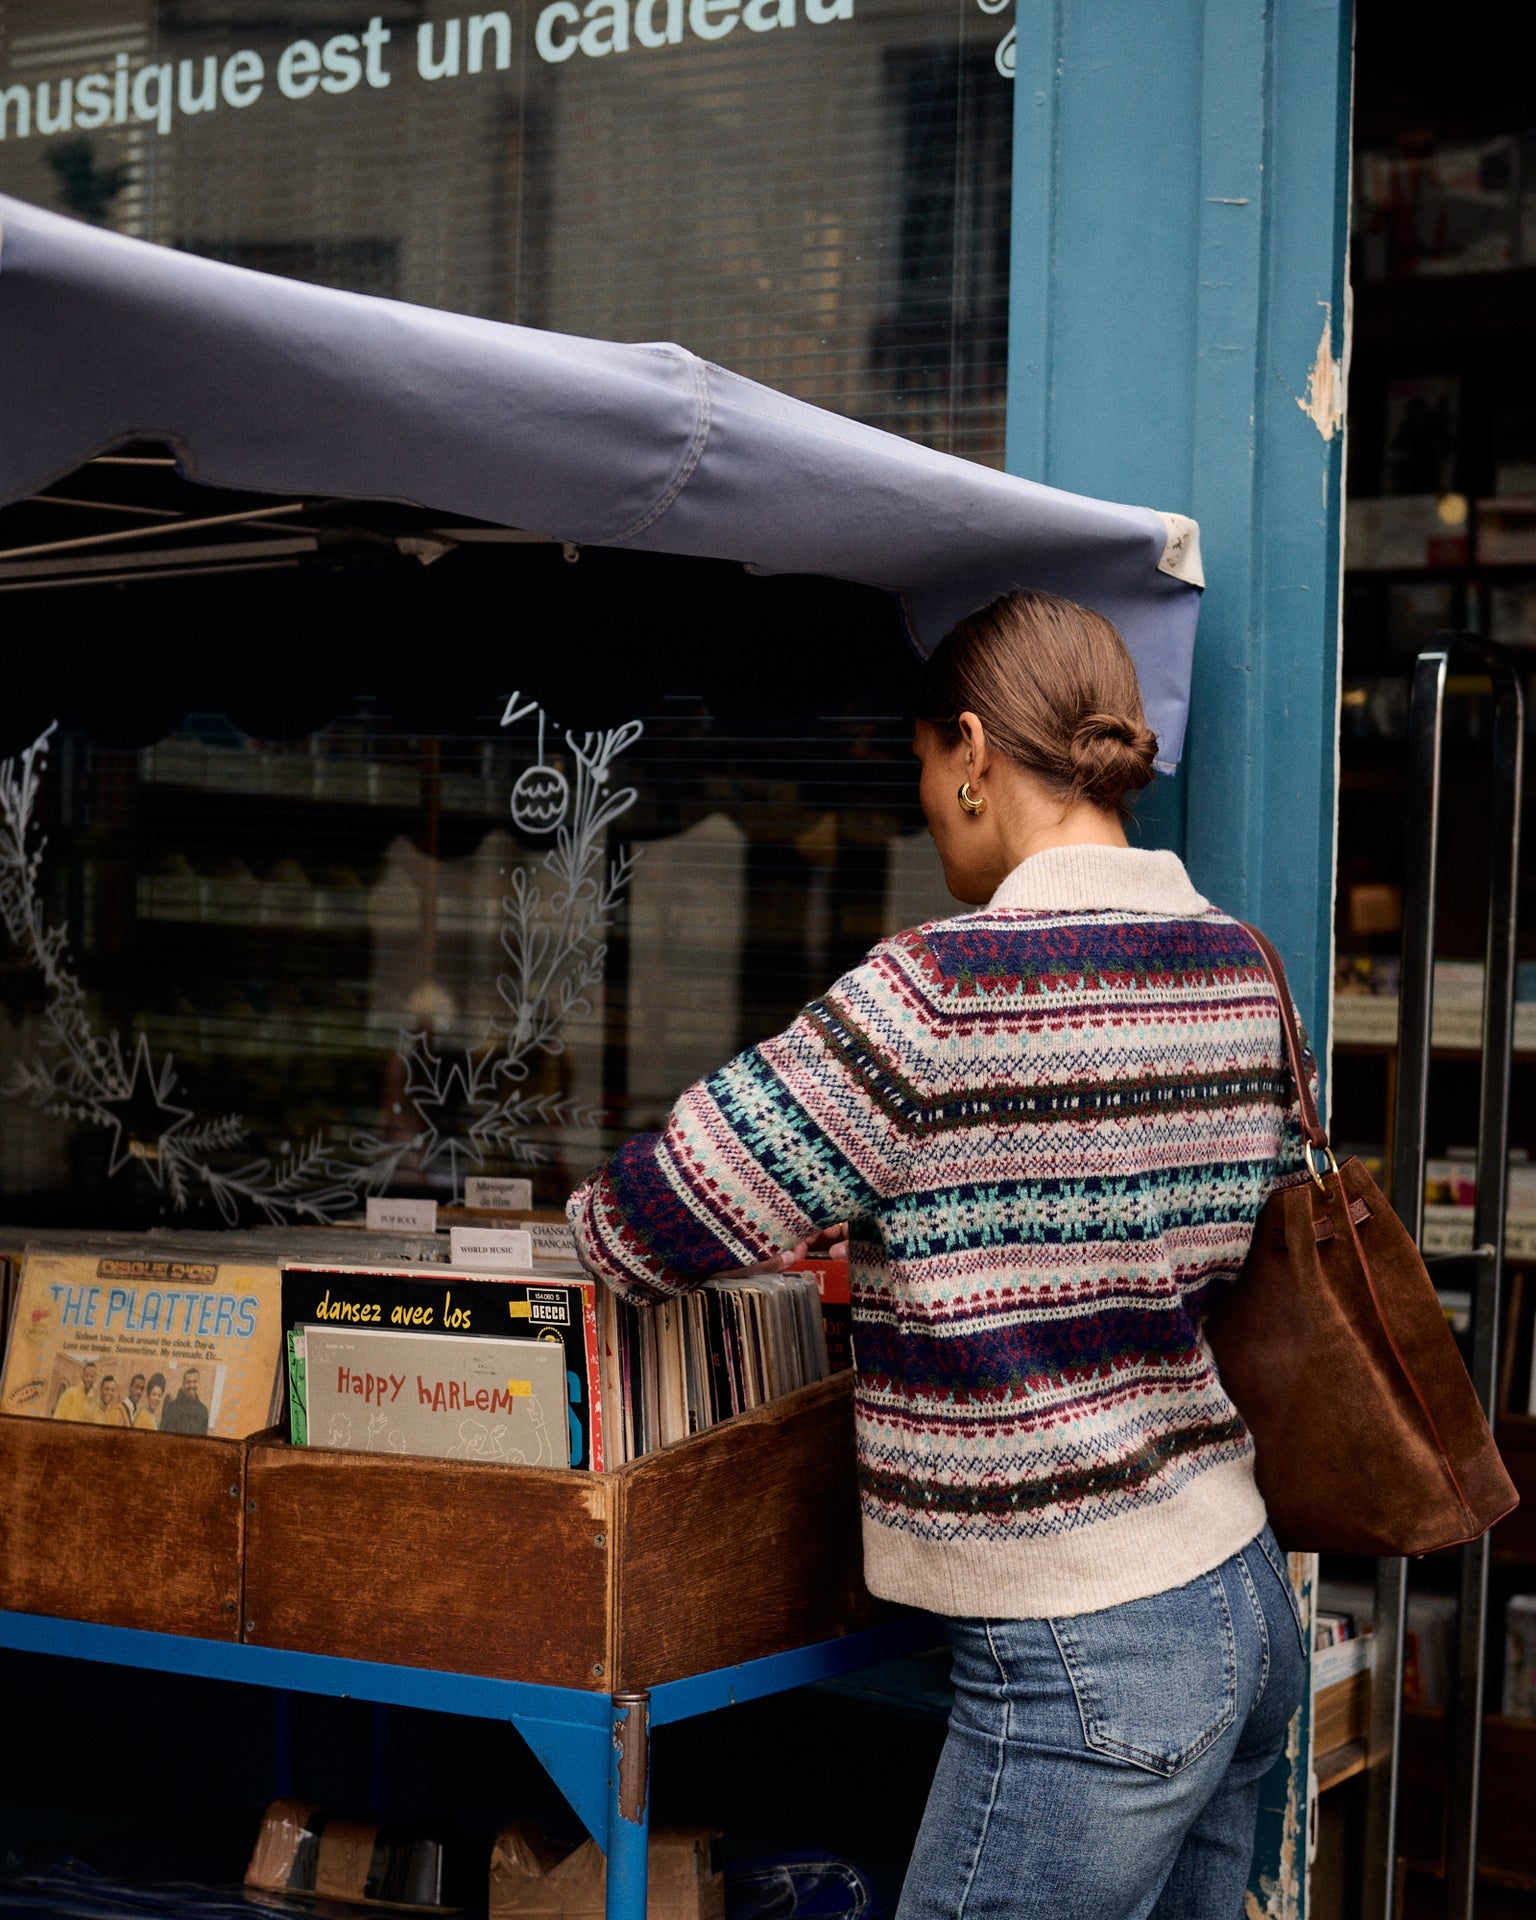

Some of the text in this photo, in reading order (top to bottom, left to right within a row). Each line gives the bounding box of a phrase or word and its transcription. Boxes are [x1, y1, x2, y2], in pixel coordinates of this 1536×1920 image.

[277, 16, 391, 100] est
[417, 11, 512, 81] un
[476, 1181, 514, 1193] Musique
[480, 1197, 511, 1207] de film
[489, 1246, 513, 1254] MUSIC
[101, 1260, 217, 1280] DISQUE D'OR
[50, 1283, 260, 1339] THE PLATTERS
[316, 1289, 472, 1329] dansez avec los
[532, 1304, 566, 1321] DECCA
[118, 1333, 134, 1344] Rock
[137, 1334, 160, 1345] around
[161, 1336, 172, 1346] the
[338, 1366, 406, 1407] Happy
